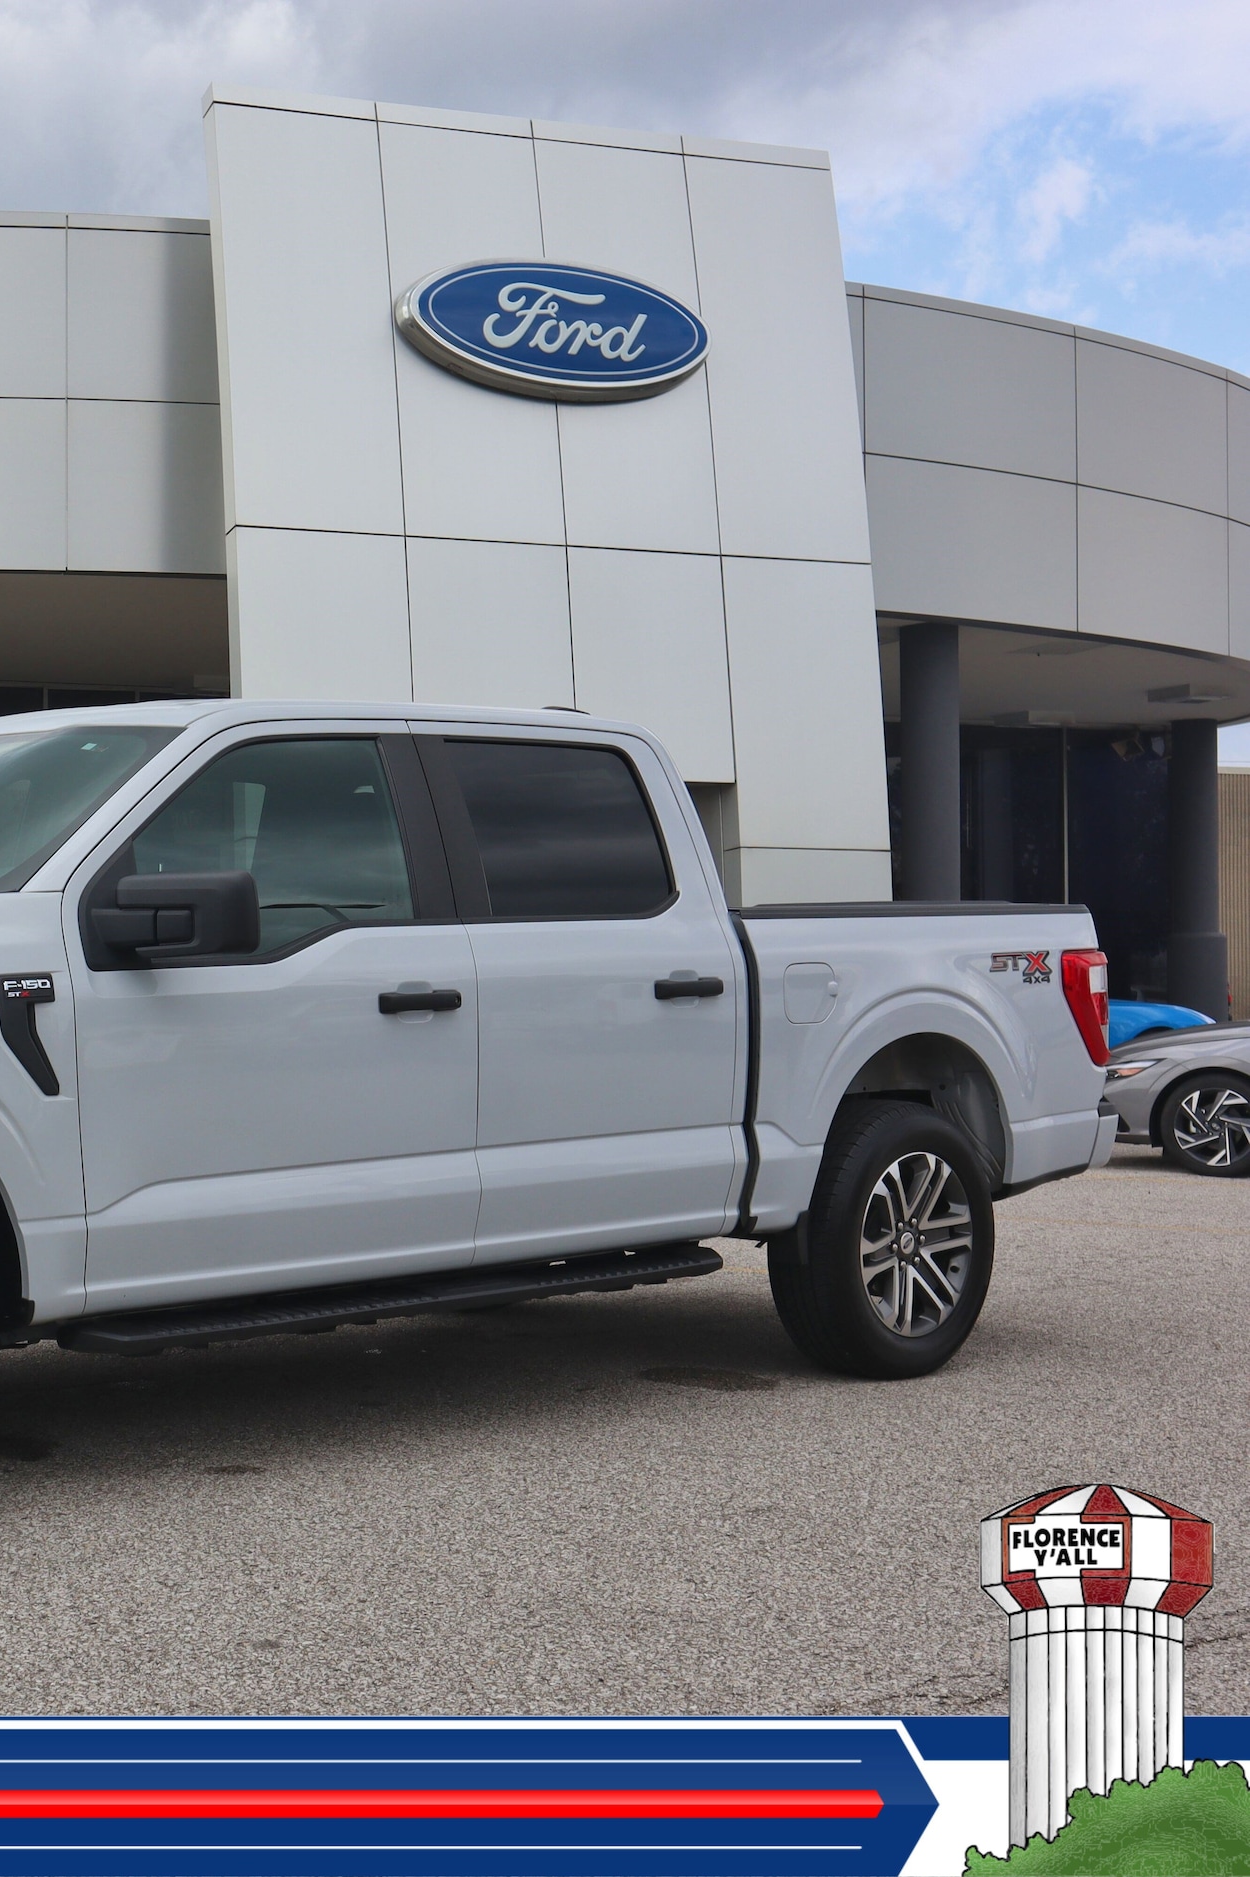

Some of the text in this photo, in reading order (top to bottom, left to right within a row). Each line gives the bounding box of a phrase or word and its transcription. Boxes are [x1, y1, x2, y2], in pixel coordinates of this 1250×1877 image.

[482, 281, 648, 363] Ford
[990, 951, 1052, 976] STX
[3, 979, 51, 990] F-150
